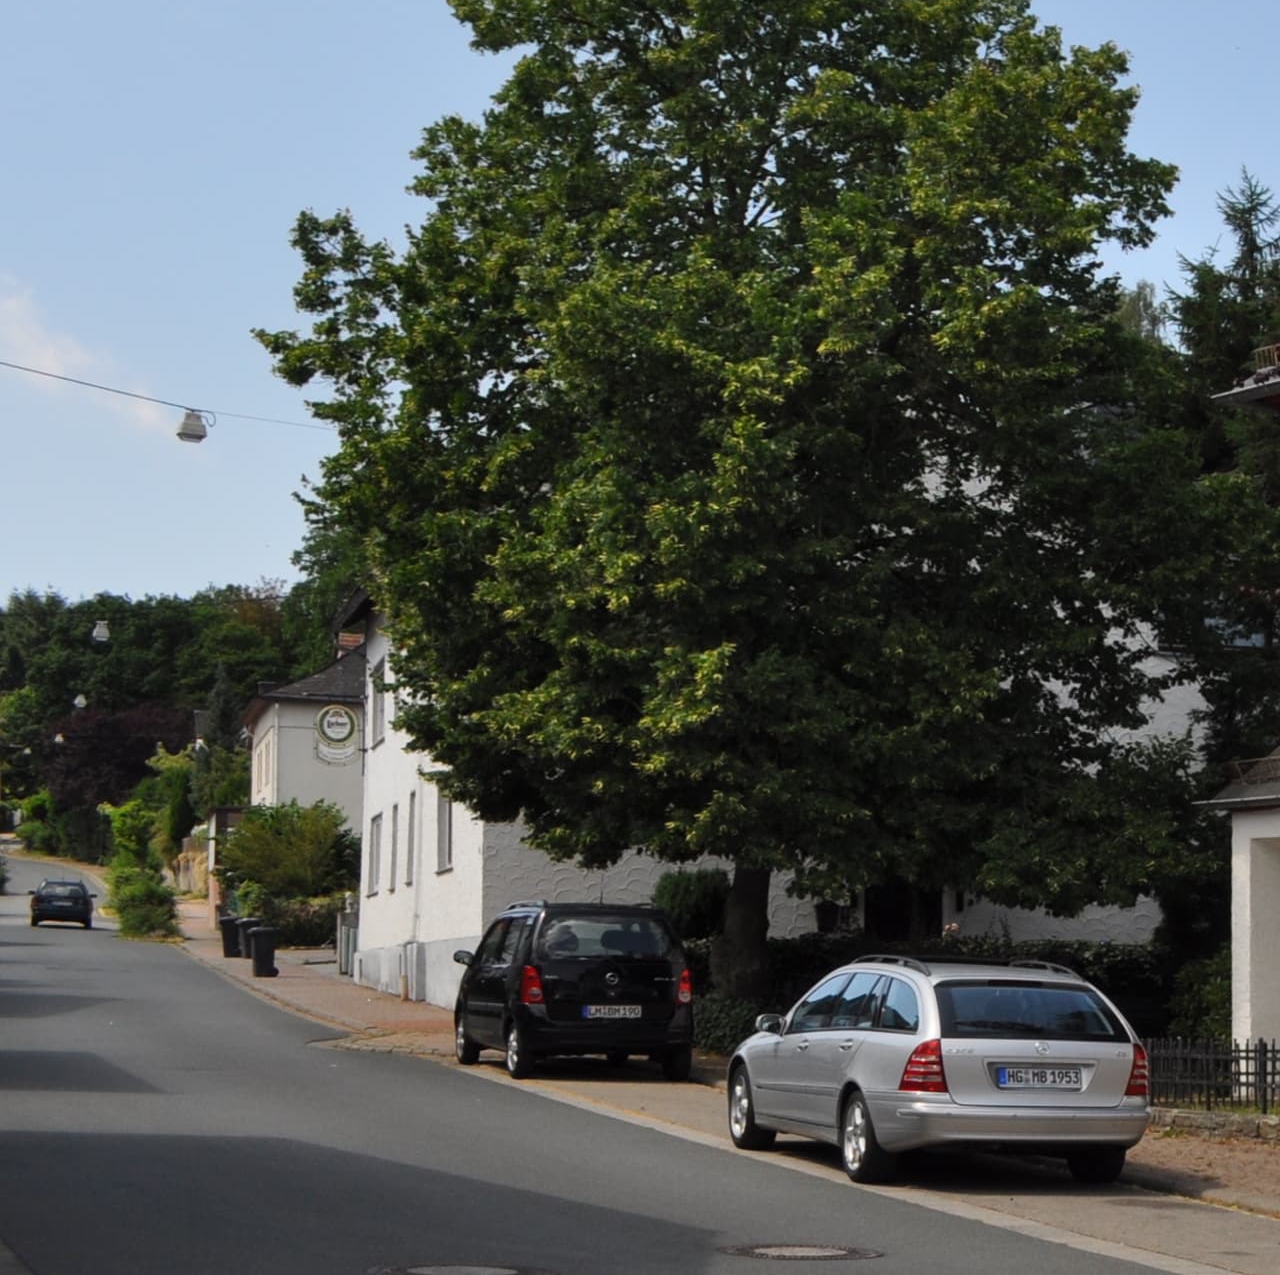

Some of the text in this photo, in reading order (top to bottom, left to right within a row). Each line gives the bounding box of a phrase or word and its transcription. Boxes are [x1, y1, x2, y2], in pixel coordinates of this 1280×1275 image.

[1007, 1070, 1080, 1084] HG MB 1953
